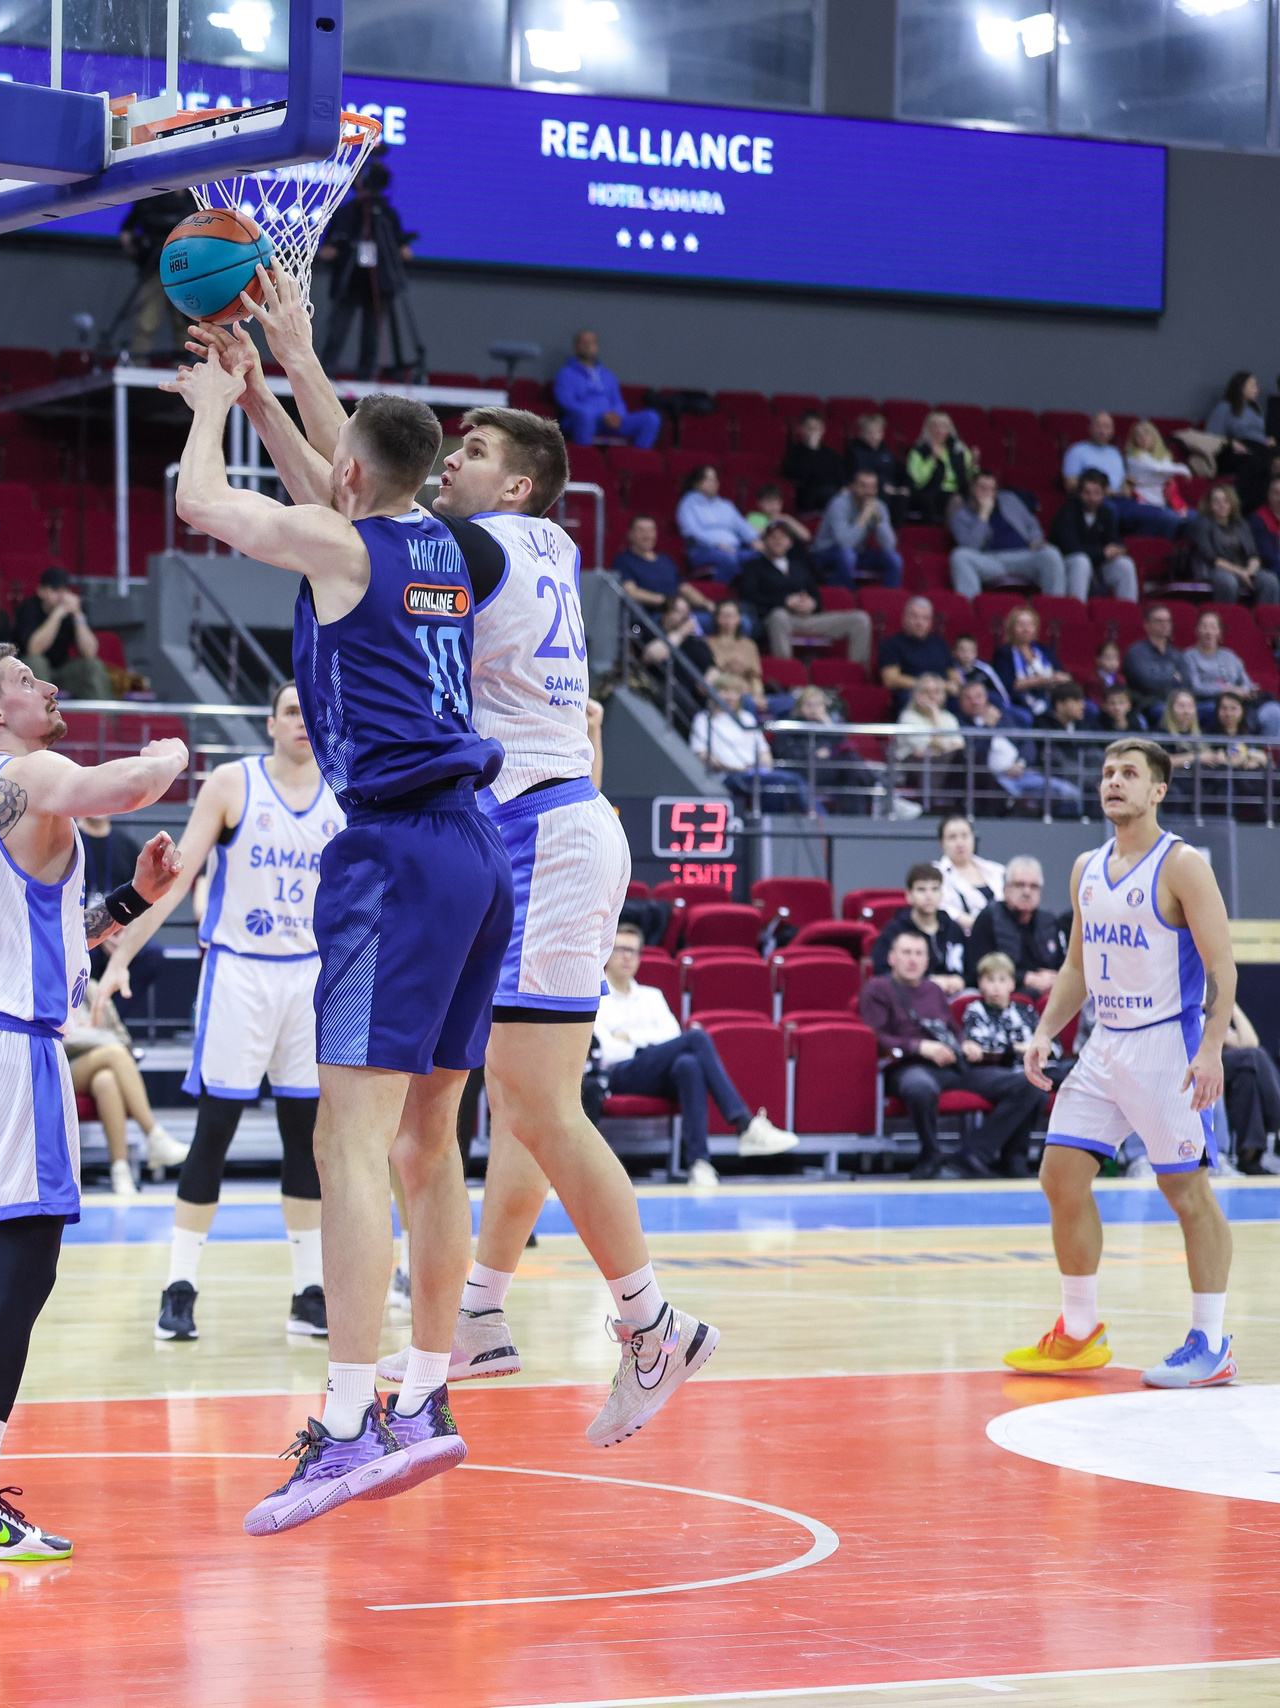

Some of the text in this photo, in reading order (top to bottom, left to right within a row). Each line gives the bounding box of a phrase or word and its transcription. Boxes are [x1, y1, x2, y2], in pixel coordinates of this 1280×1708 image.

[541, 118, 774, 175] REALLIANCE
[587, 181, 648, 210] HOTEL
[169, 256, 189, 274] FIBA
[409, 590, 455, 611] WINLINE
[534, 575, 586, 662] 20
[415, 625, 470, 716] 10
[249, 844, 320, 874] SAMAR
[274, 876, 305, 904] 16
[1083, 921, 1150, 950] AMARA
[1100, 953, 1111, 981] 1
[1098, 994, 1153, 1009] РОССЕТИ
